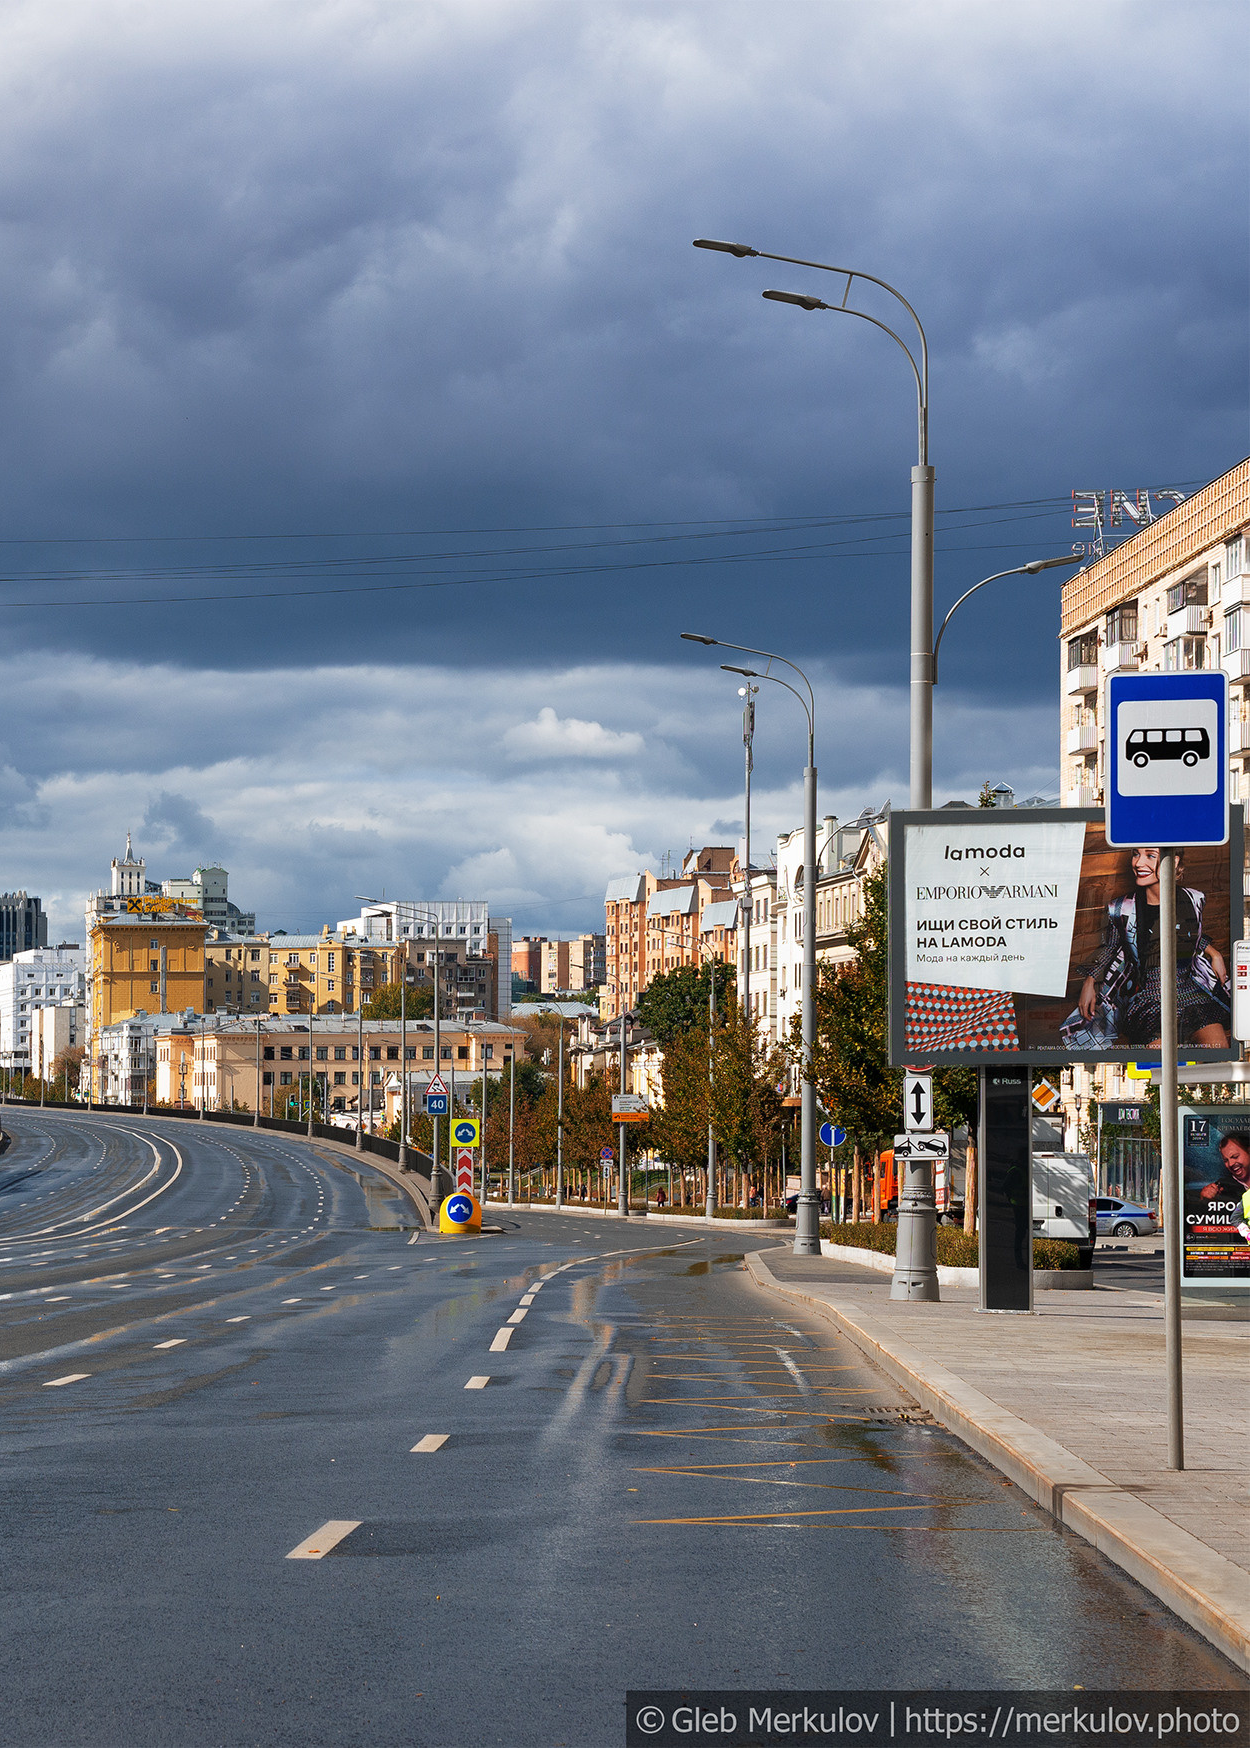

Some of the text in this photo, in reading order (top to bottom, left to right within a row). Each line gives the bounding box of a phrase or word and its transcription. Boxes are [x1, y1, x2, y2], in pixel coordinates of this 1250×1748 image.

[944, 844, 1025, 861] lamoda
[916, 885, 1058, 900] EMPORIO ARMANI
[917, 916, 1058, 933] ИЩИ СВОЙ СТИЛЬ
[917, 936, 1007, 949] НА LAMODA
[916, 953, 1025, 964] Мода на каждый день
[1002, 1077, 1022, 1085] Russ
[430, 1100, 444, 1110] 40
[1190, 1120, 1207, 1132] 17
[1207, 1201, 1241, 1212] ЯРО
